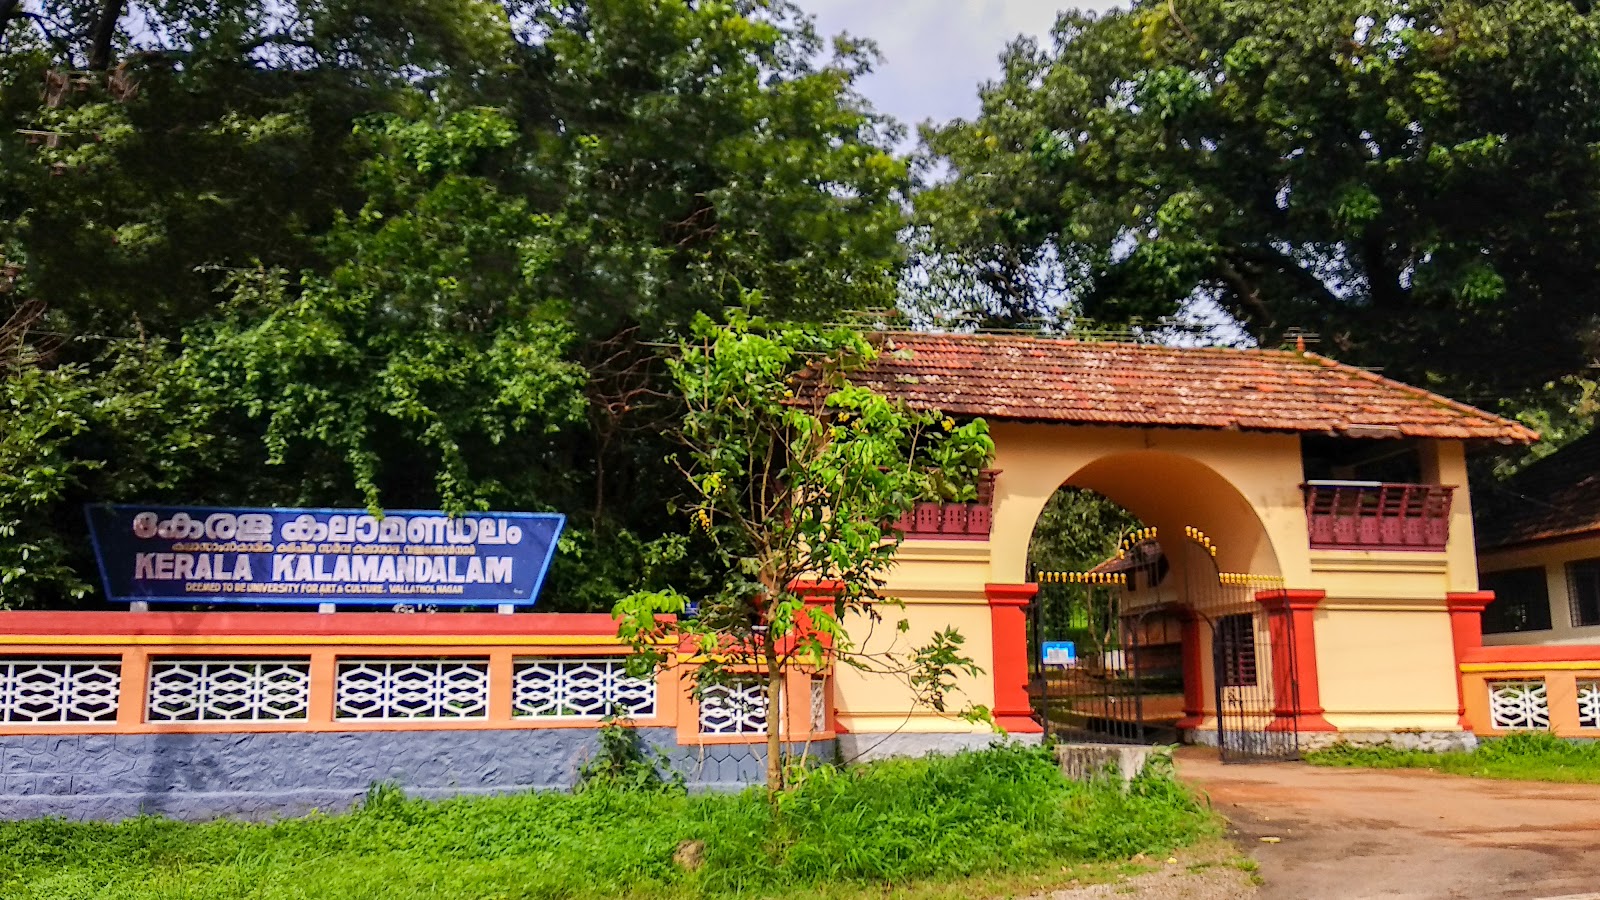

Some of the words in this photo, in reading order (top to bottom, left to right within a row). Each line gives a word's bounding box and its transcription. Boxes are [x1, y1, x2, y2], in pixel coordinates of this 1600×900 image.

[133, 511, 273, 542] കേരള
[281, 513, 522, 545] കലാമണ്ഡലം
[135, 552, 253, 581] KERALA
[272, 554, 513, 584] KALAMANDALAM
[185, 582, 221, 592] DEEMED
[222, 582, 233, 592] TO
[235, 583, 246, 593] BE
[247, 583, 299, 594] UNIVERSITY
[301, 583, 319, 594] FOR
[319, 584, 336, 594] ART
[337, 585, 344, 594] &
[389, 584, 436, 595] VALLATHOL
[437, 585, 464, 594] NAGAR
